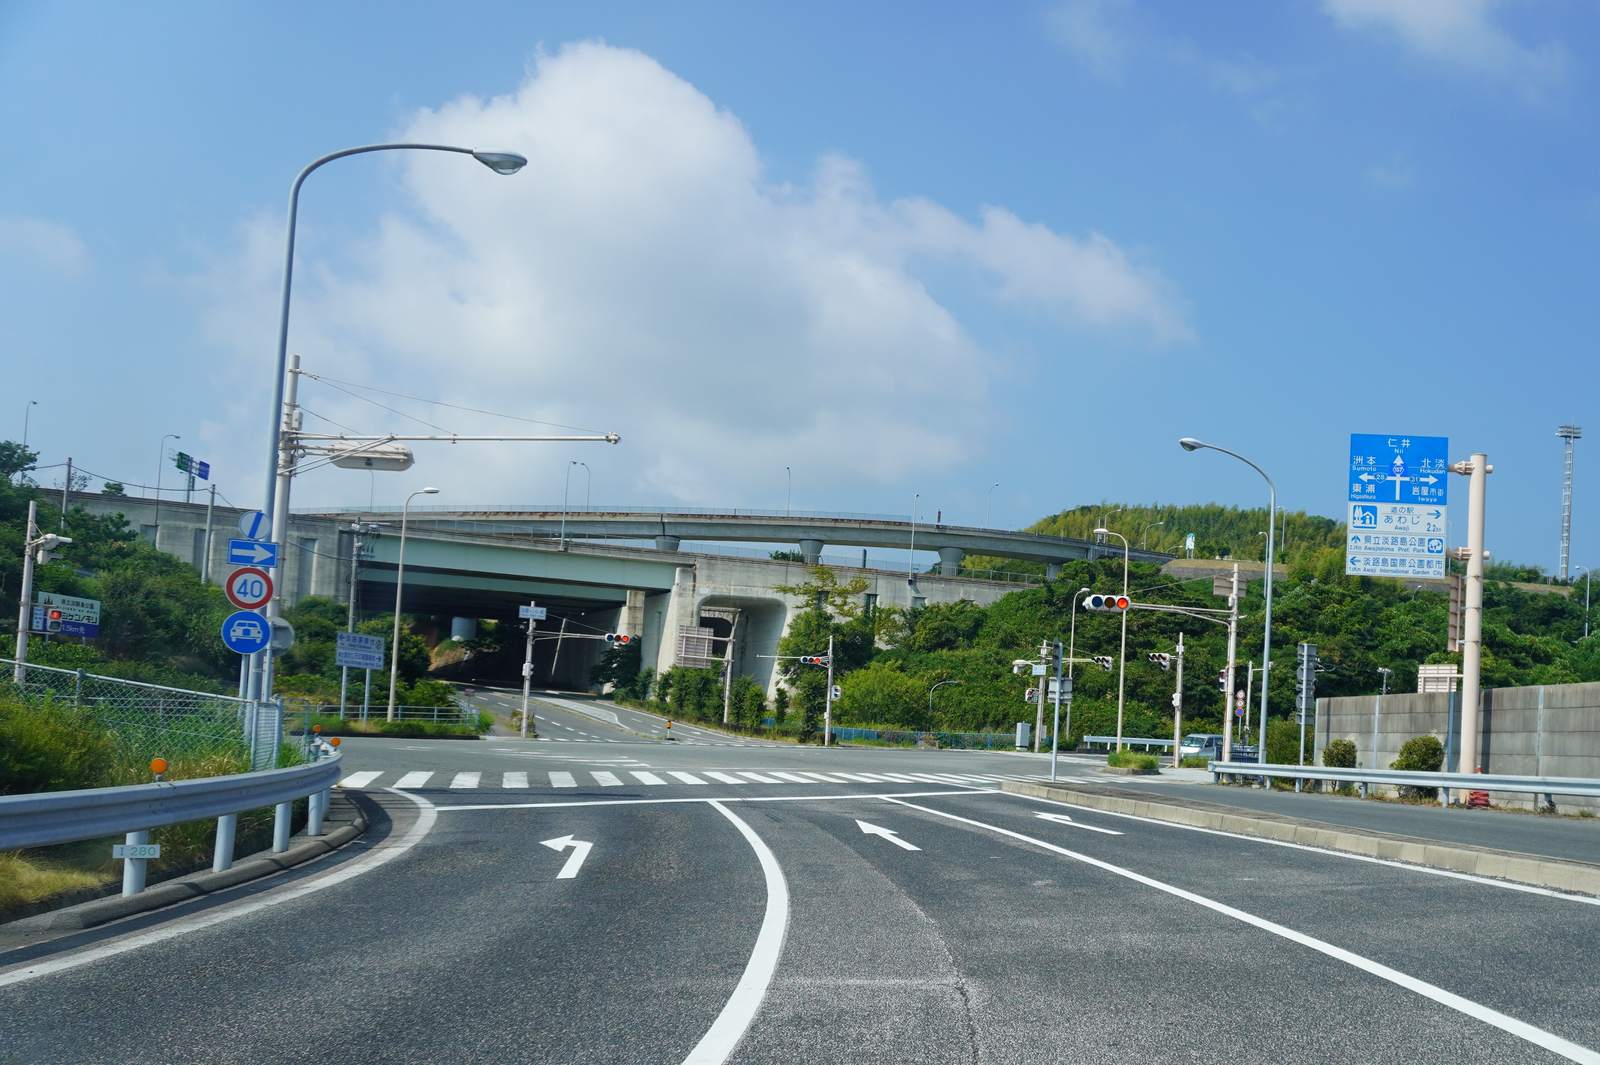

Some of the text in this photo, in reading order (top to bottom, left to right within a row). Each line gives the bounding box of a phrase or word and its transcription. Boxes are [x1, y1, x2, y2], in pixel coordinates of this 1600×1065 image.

[1388, 438, 1411, 448] 仁井
[1353, 455, 1377, 465] 洲本
[1421, 458, 1445, 469] 北淡
[1376, 473, 1385, 481] 28
[1352, 483, 1376, 493] 東浦
[1384, 515, 1421, 525] あわじ
[1394, 524, 1410, 532] Awaji
[1364, 535, 1426, 547] 県立淡路島公園
[1363, 556, 1443, 570] 淡路島国際公園都市
[236, 579, 263, 598] 40
